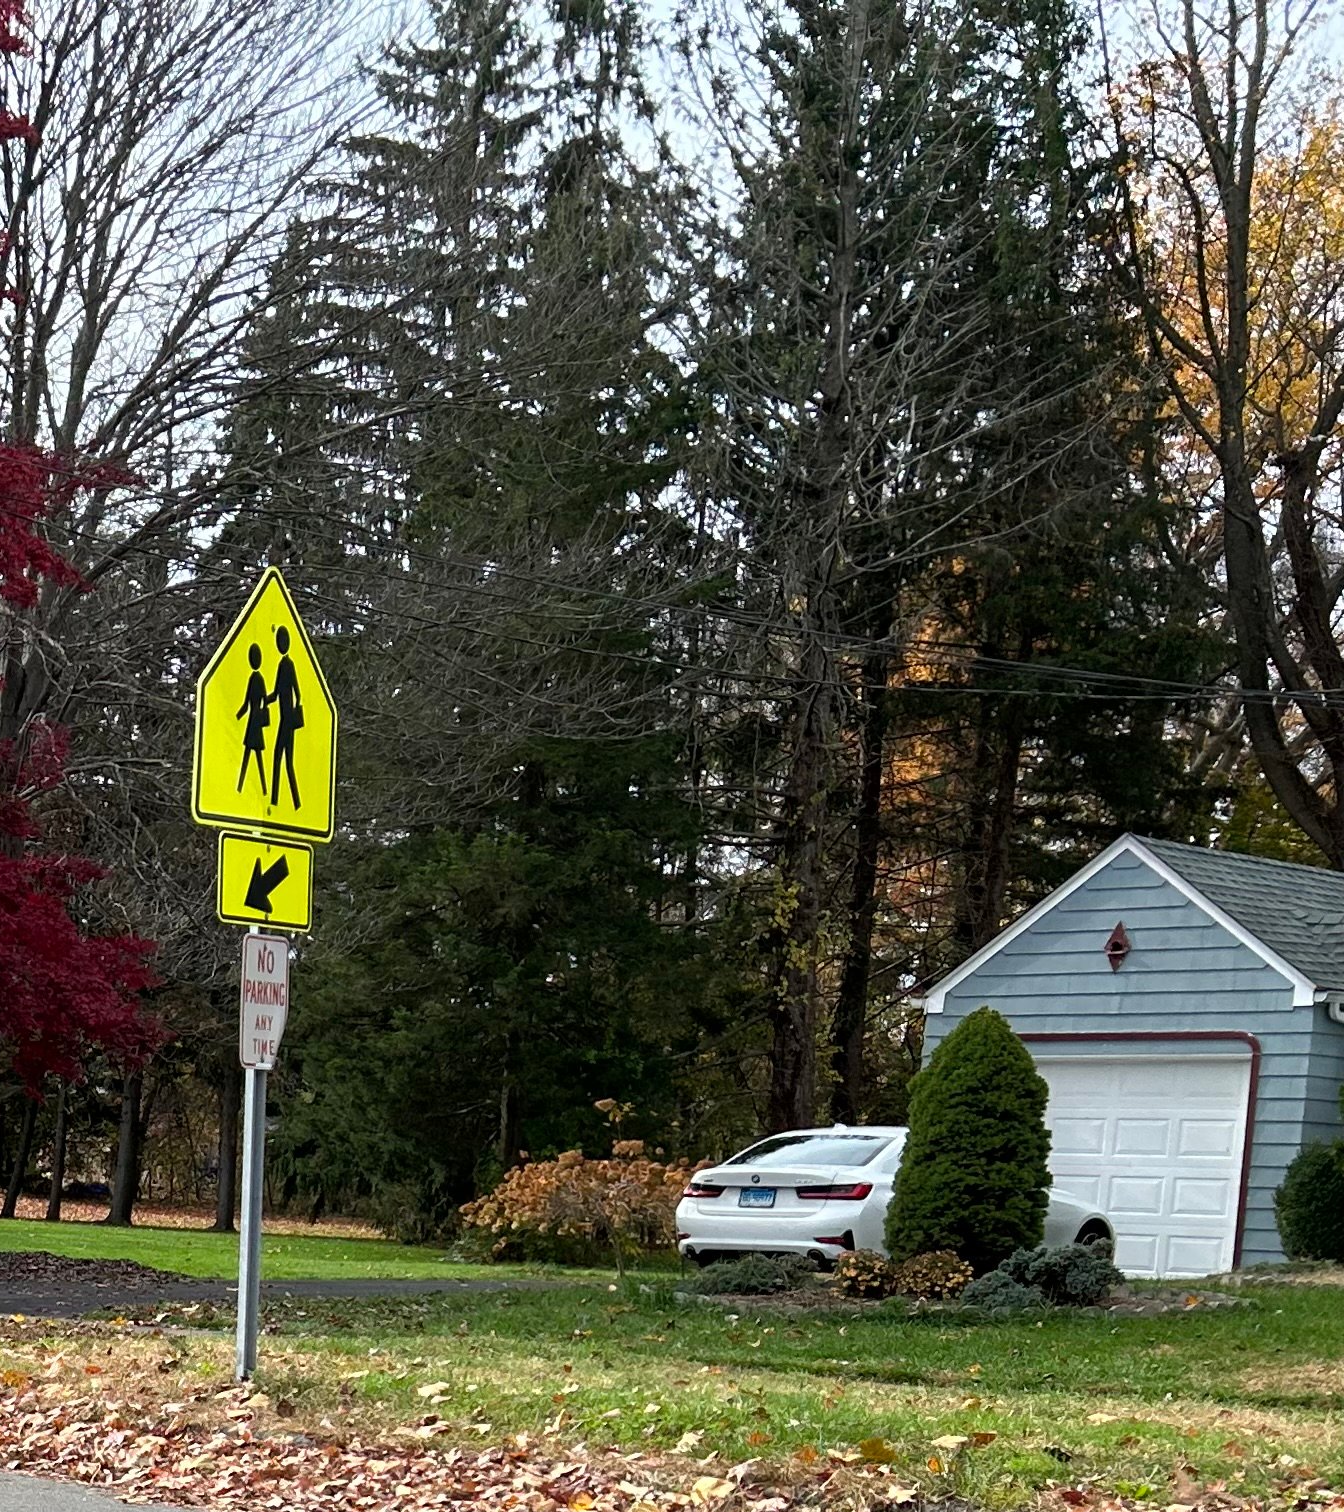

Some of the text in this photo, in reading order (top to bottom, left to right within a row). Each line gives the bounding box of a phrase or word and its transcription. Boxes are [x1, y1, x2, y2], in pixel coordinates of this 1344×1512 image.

[257, 949, 275, 974] NO
[244, 980, 286, 1007] PARKING
[255, 1015, 274, 1032] ANY
[253, 1038, 276, 1056] TIME
